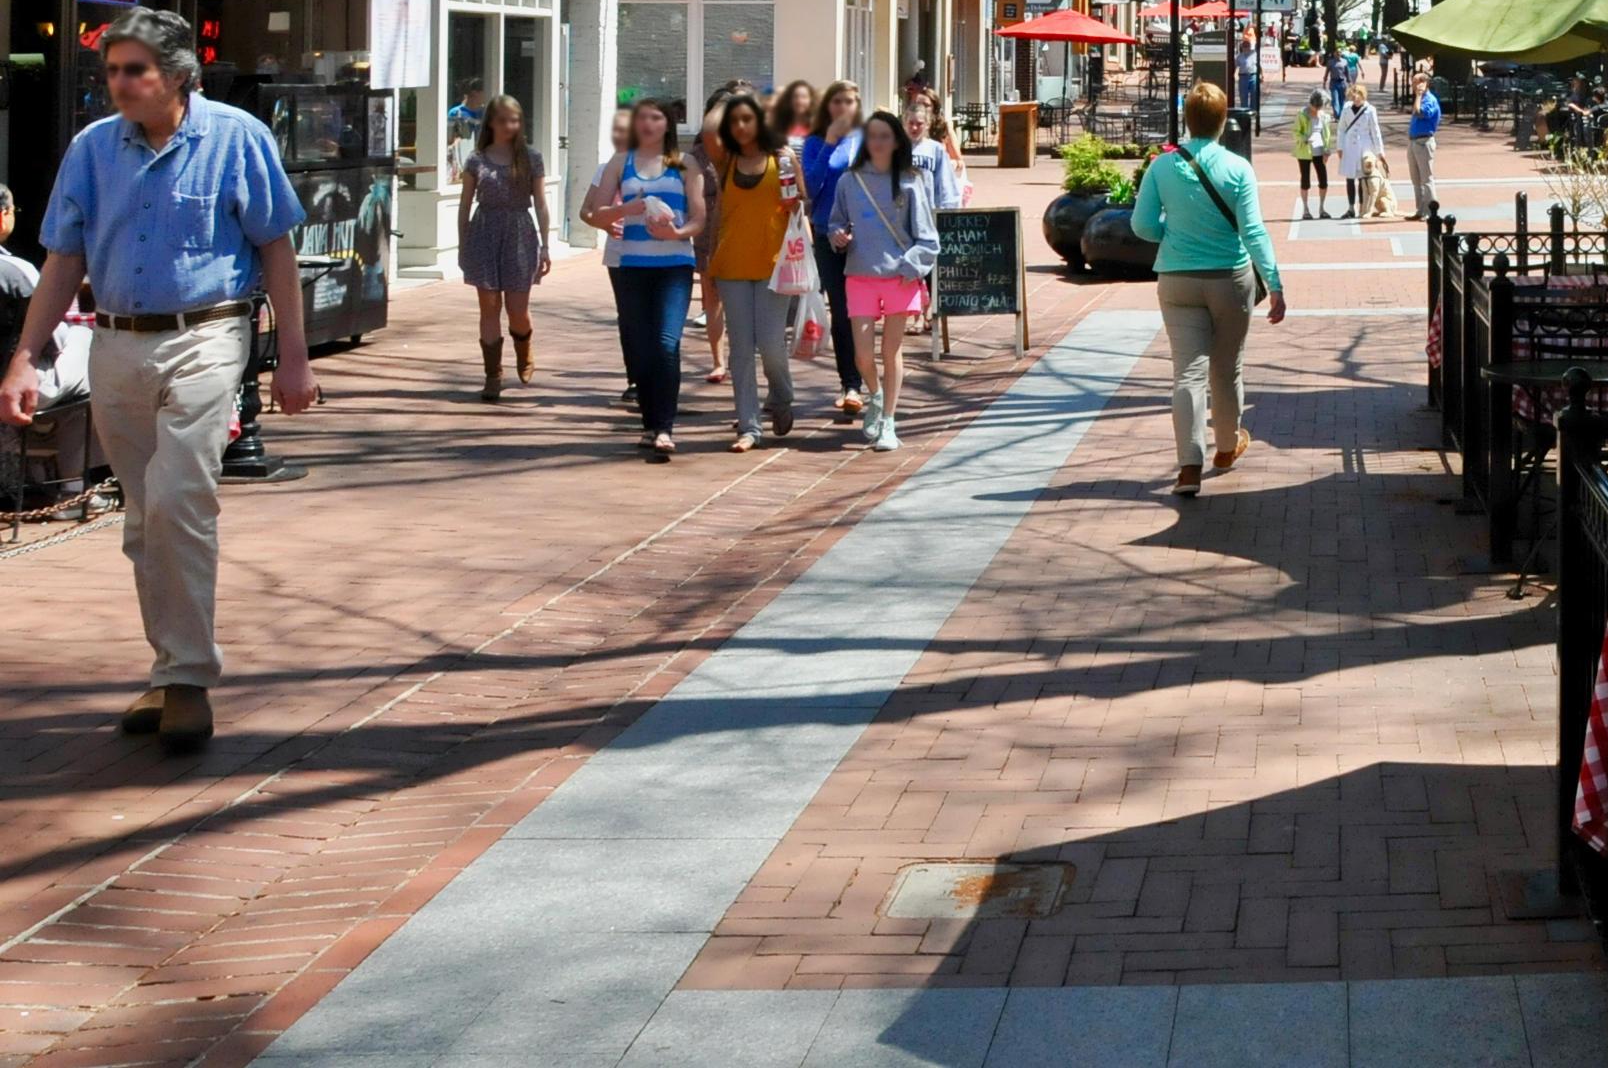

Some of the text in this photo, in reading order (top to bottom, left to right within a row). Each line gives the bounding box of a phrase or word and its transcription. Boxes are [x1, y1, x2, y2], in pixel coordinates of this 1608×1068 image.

[943, 215, 991, 228] TURKEY
[298, 223, 328, 255] JAVA
[957, 230, 987, 243] HAM
[938, 266, 979, 279] PHILLY
[938, 294, 979, 308] POTATO
